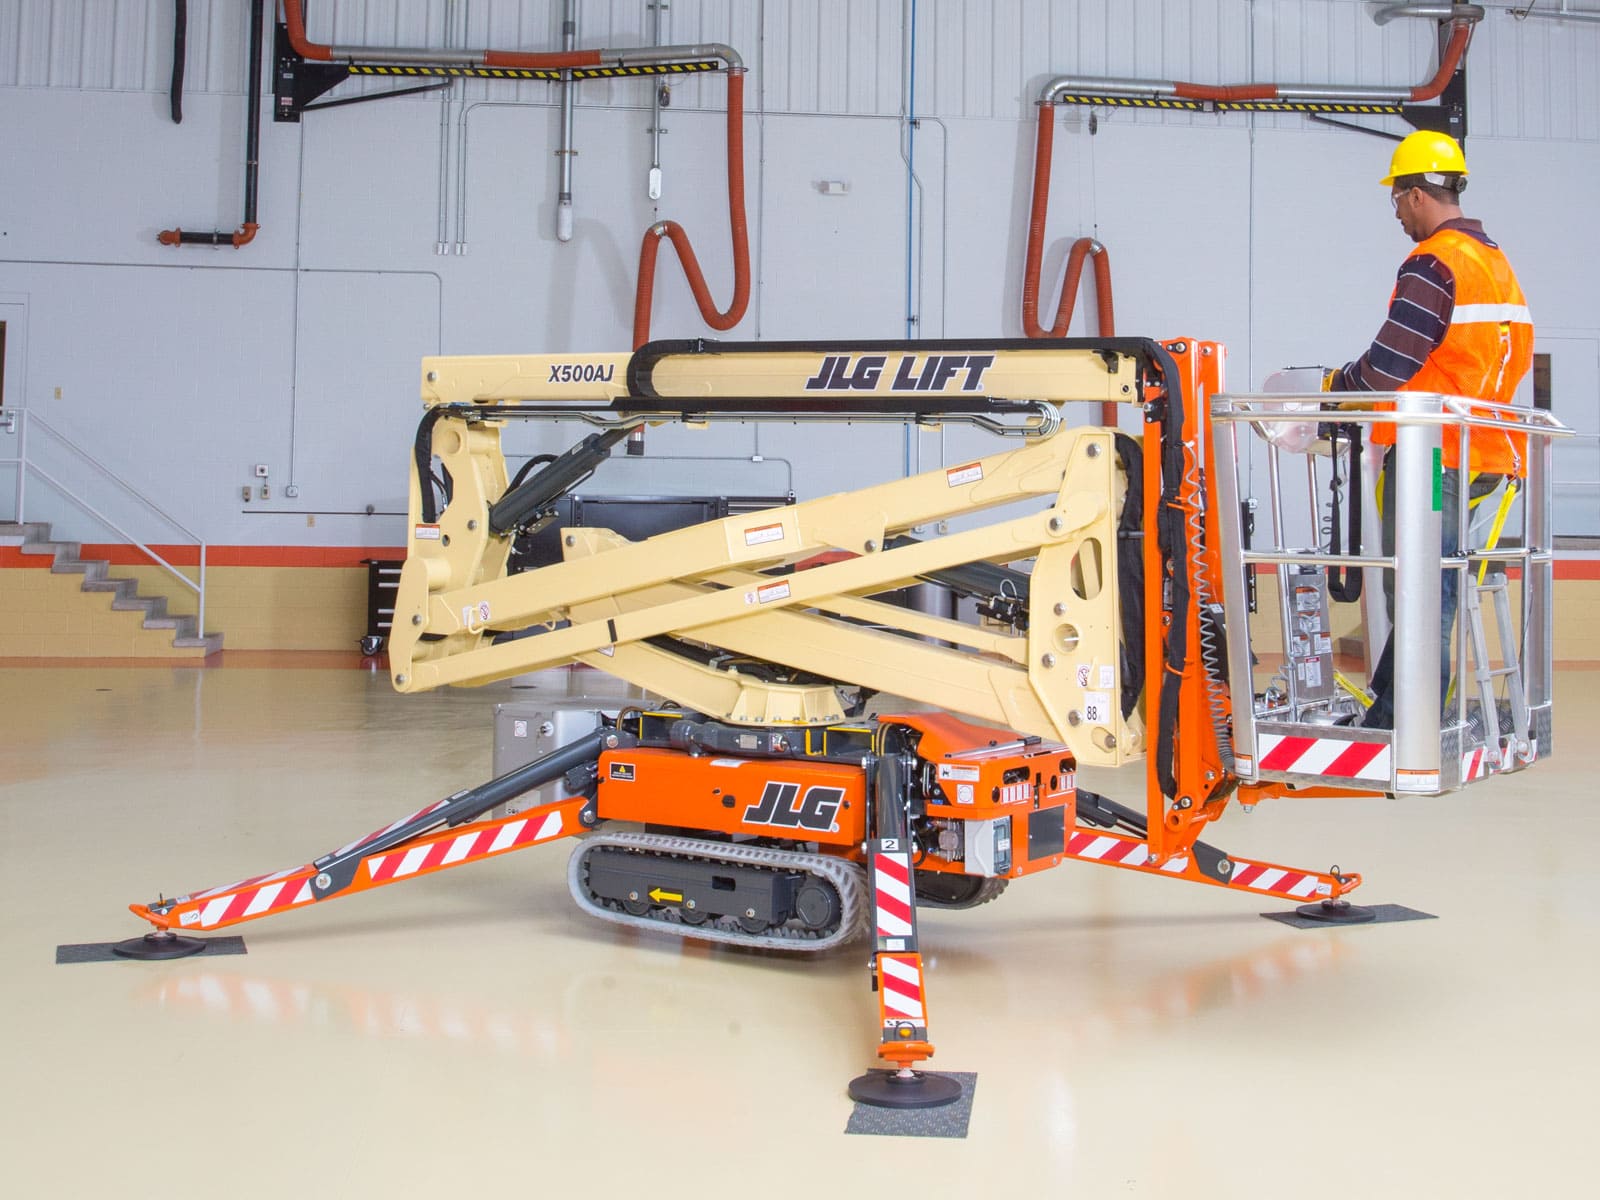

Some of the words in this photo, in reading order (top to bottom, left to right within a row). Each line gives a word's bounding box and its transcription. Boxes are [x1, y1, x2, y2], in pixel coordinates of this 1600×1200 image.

[548, 364, 615, 382] X500AJ
[805, 355, 888, 391] JLG
[891, 354, 995, 392] LIFT
[742, 781, 846, 832] JLG
[884, 839, 896, 849] 2
